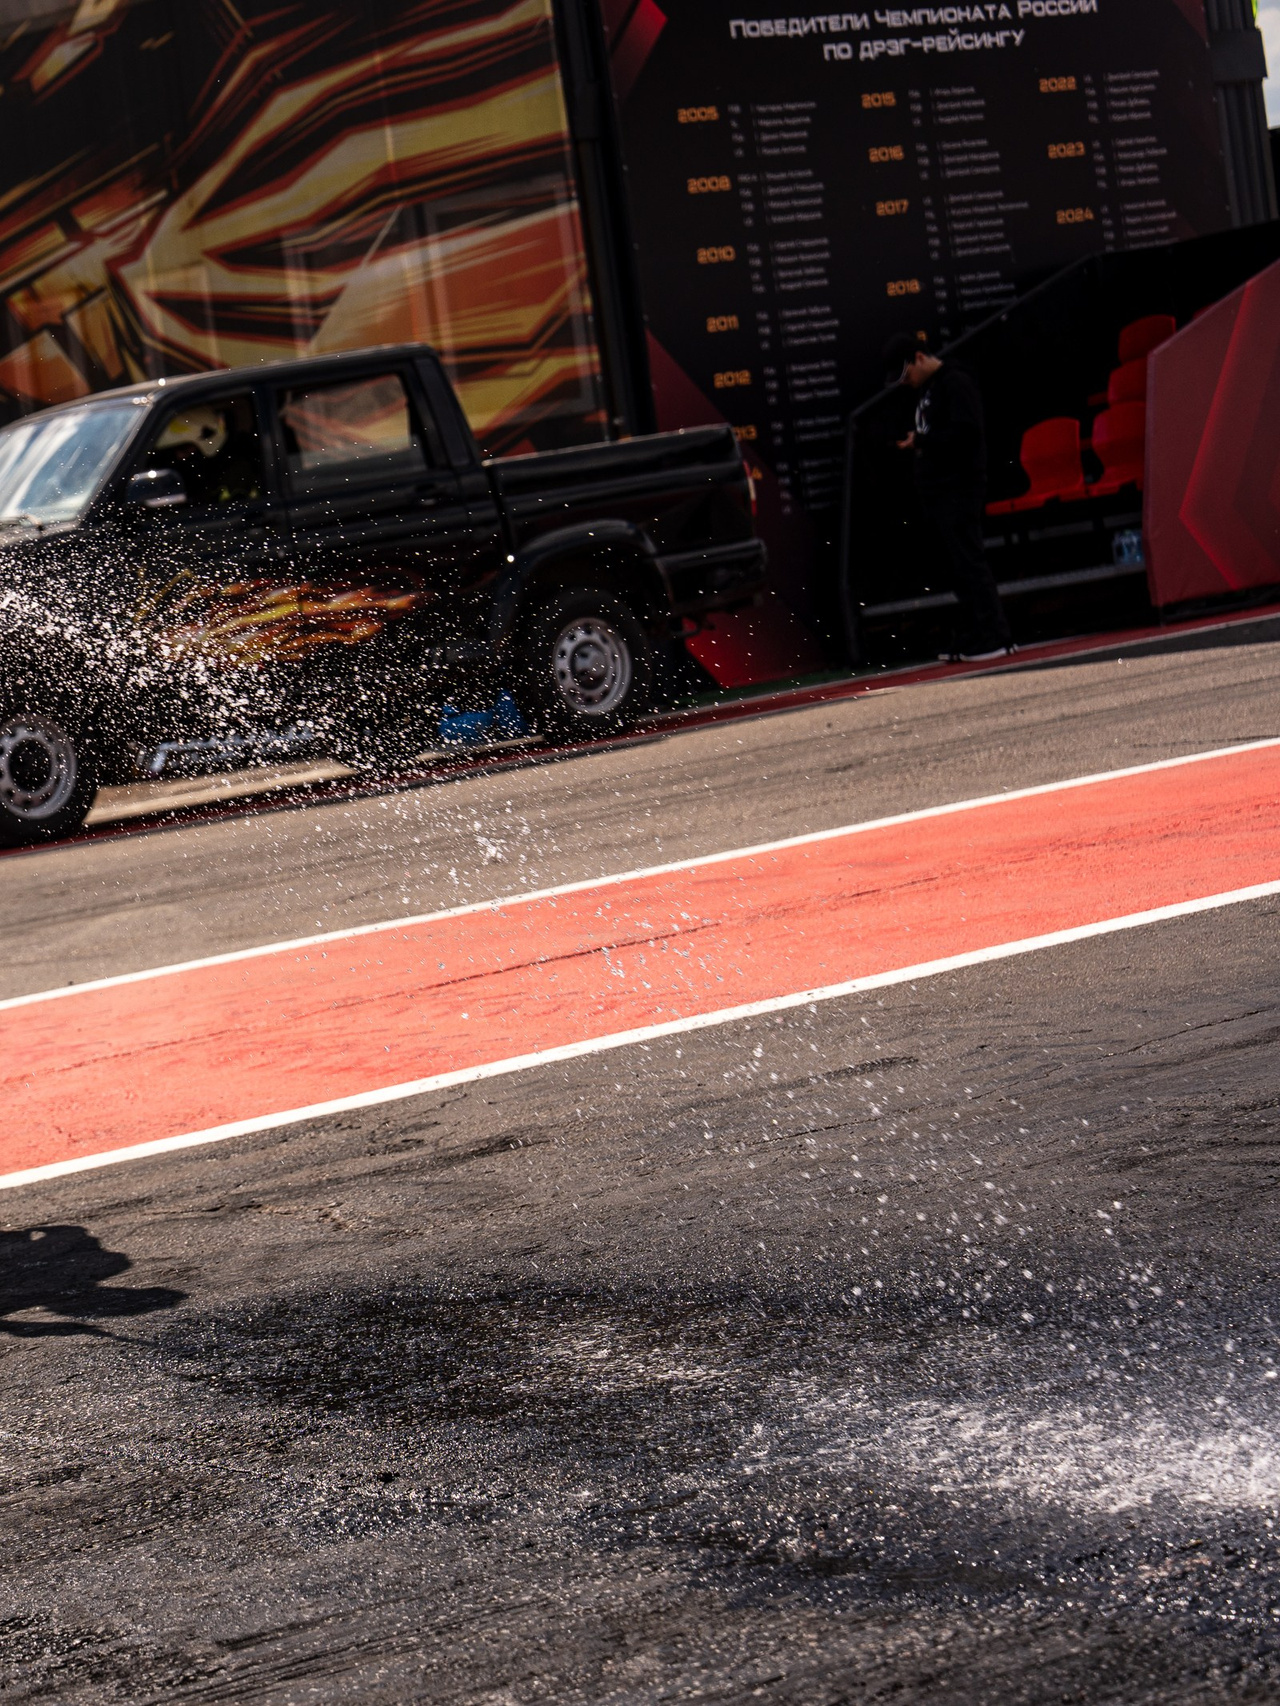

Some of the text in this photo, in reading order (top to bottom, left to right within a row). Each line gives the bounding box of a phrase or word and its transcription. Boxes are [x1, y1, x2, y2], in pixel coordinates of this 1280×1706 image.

[823, 42, 853, 61] ПО
[1039, 76, 1077, 93] 2022
[861, 91, 897, 109] 2015
[677, 105, 719, 123] 2005
[869, 145, 905, 163] 2016
[1048, 141, 1085, 159] 2023
[875, 199, 909, 216] 2017
[1056, 207, 1094, 225] 2024
[697, 245, 736, 264] 2010
[706, 315, 739, 333] 2011
[713, 369, 751, 389] 2012
